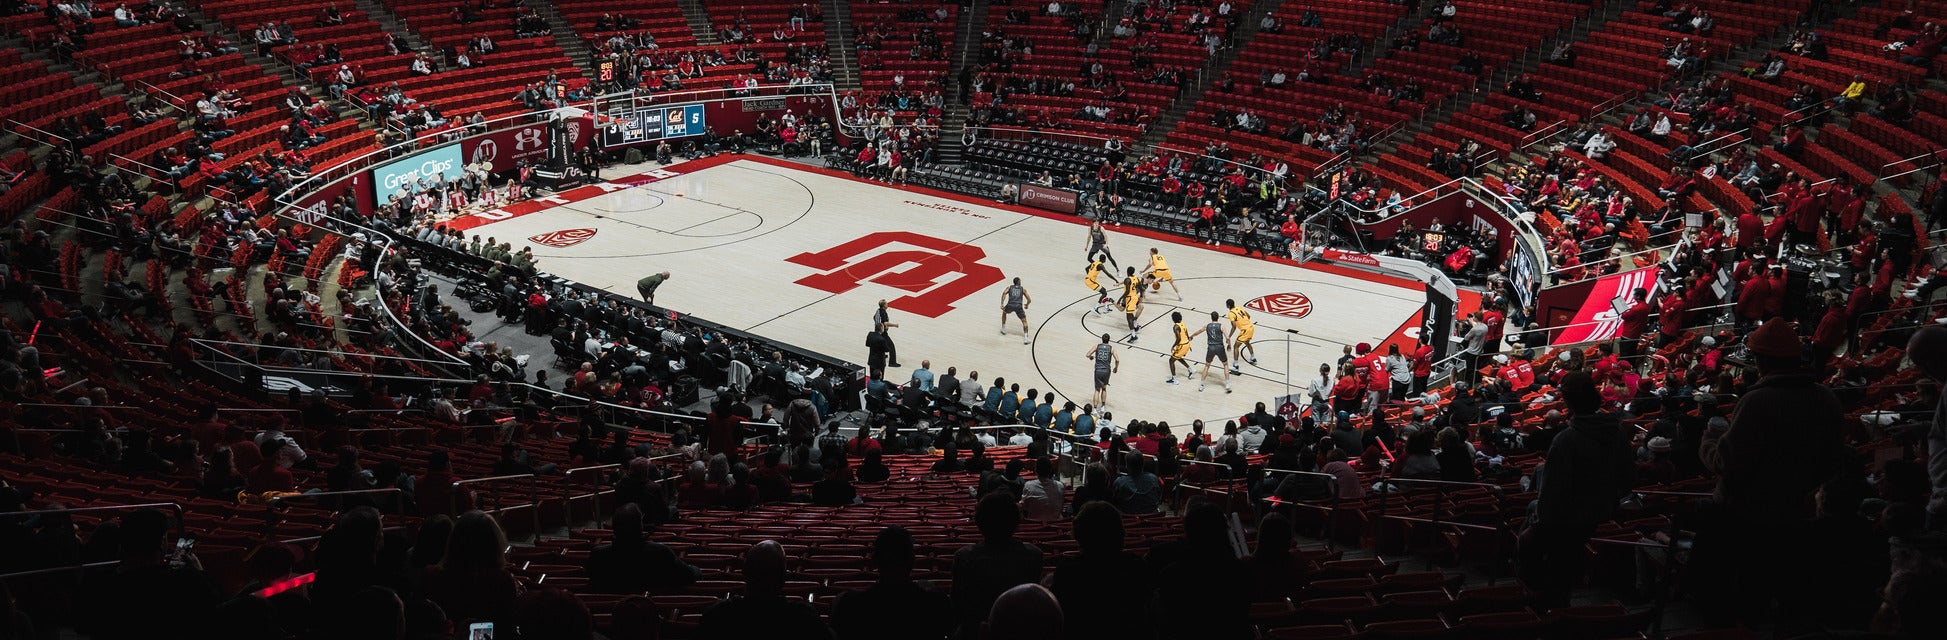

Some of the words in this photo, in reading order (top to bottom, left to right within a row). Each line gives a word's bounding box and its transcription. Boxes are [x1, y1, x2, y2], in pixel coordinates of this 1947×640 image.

[601, 69, 612, 80] 20
[669, 110, 683, 123] Cal
[1036, 192, 1060, 201] CRIMSON
[1426, 241, 1438, 251] 20
[1372, 359, 1382, 371] 5
